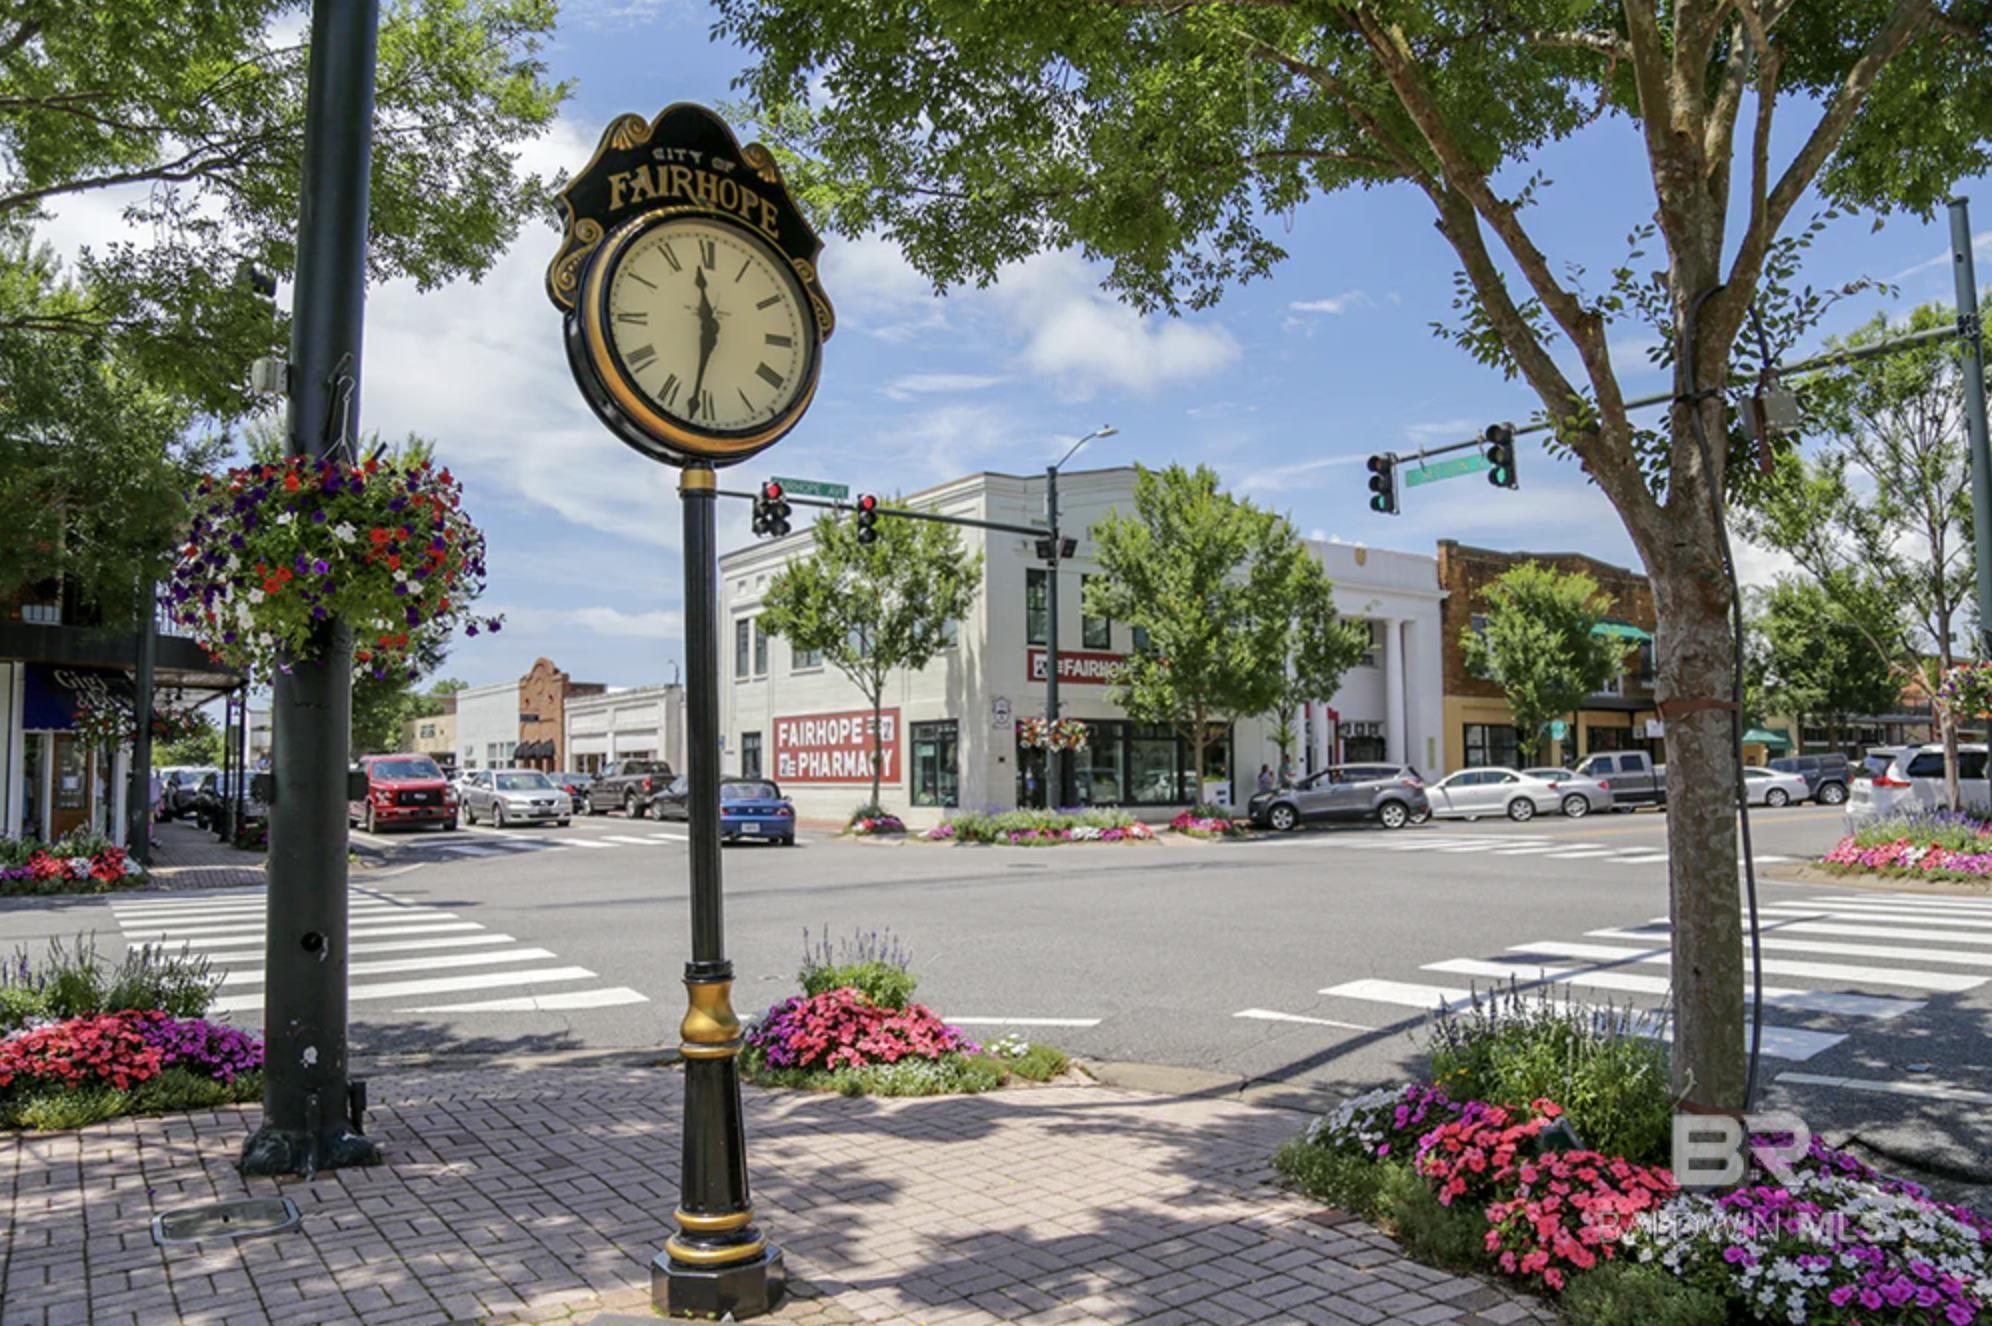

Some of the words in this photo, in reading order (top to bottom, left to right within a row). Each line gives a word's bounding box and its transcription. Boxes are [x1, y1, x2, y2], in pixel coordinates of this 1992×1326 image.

[651, 147, 704, 164] CITY
[712, 157, 737, 172] OF
[608, 164, 780, 239] FAIRHOPE
[778, 717, 864, 747] FAIRHOPE
